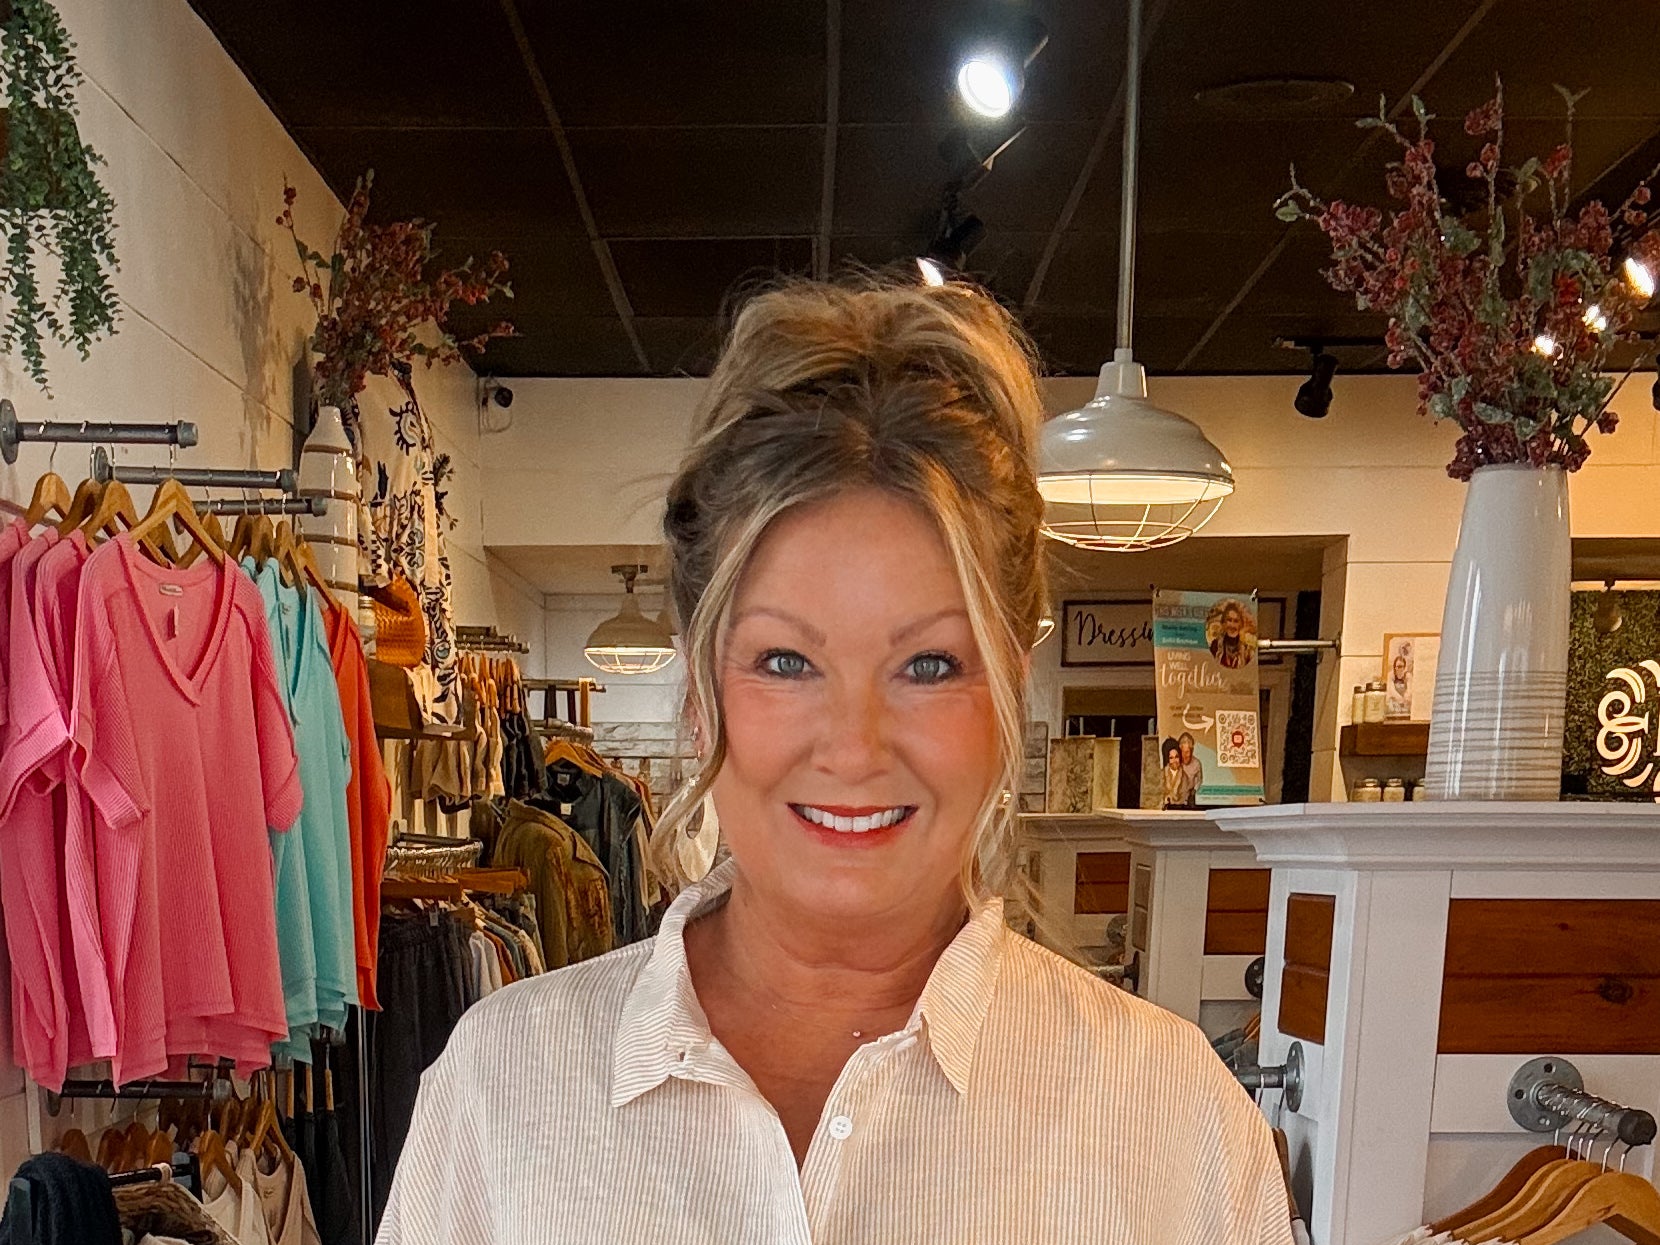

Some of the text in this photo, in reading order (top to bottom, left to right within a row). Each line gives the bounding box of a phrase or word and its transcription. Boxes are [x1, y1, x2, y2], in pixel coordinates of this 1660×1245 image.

[1073, 610, 1154, 648] Dressi
[1167, 651, 1191, 661] LIVING
[1161, 662, 1226, 698] together
